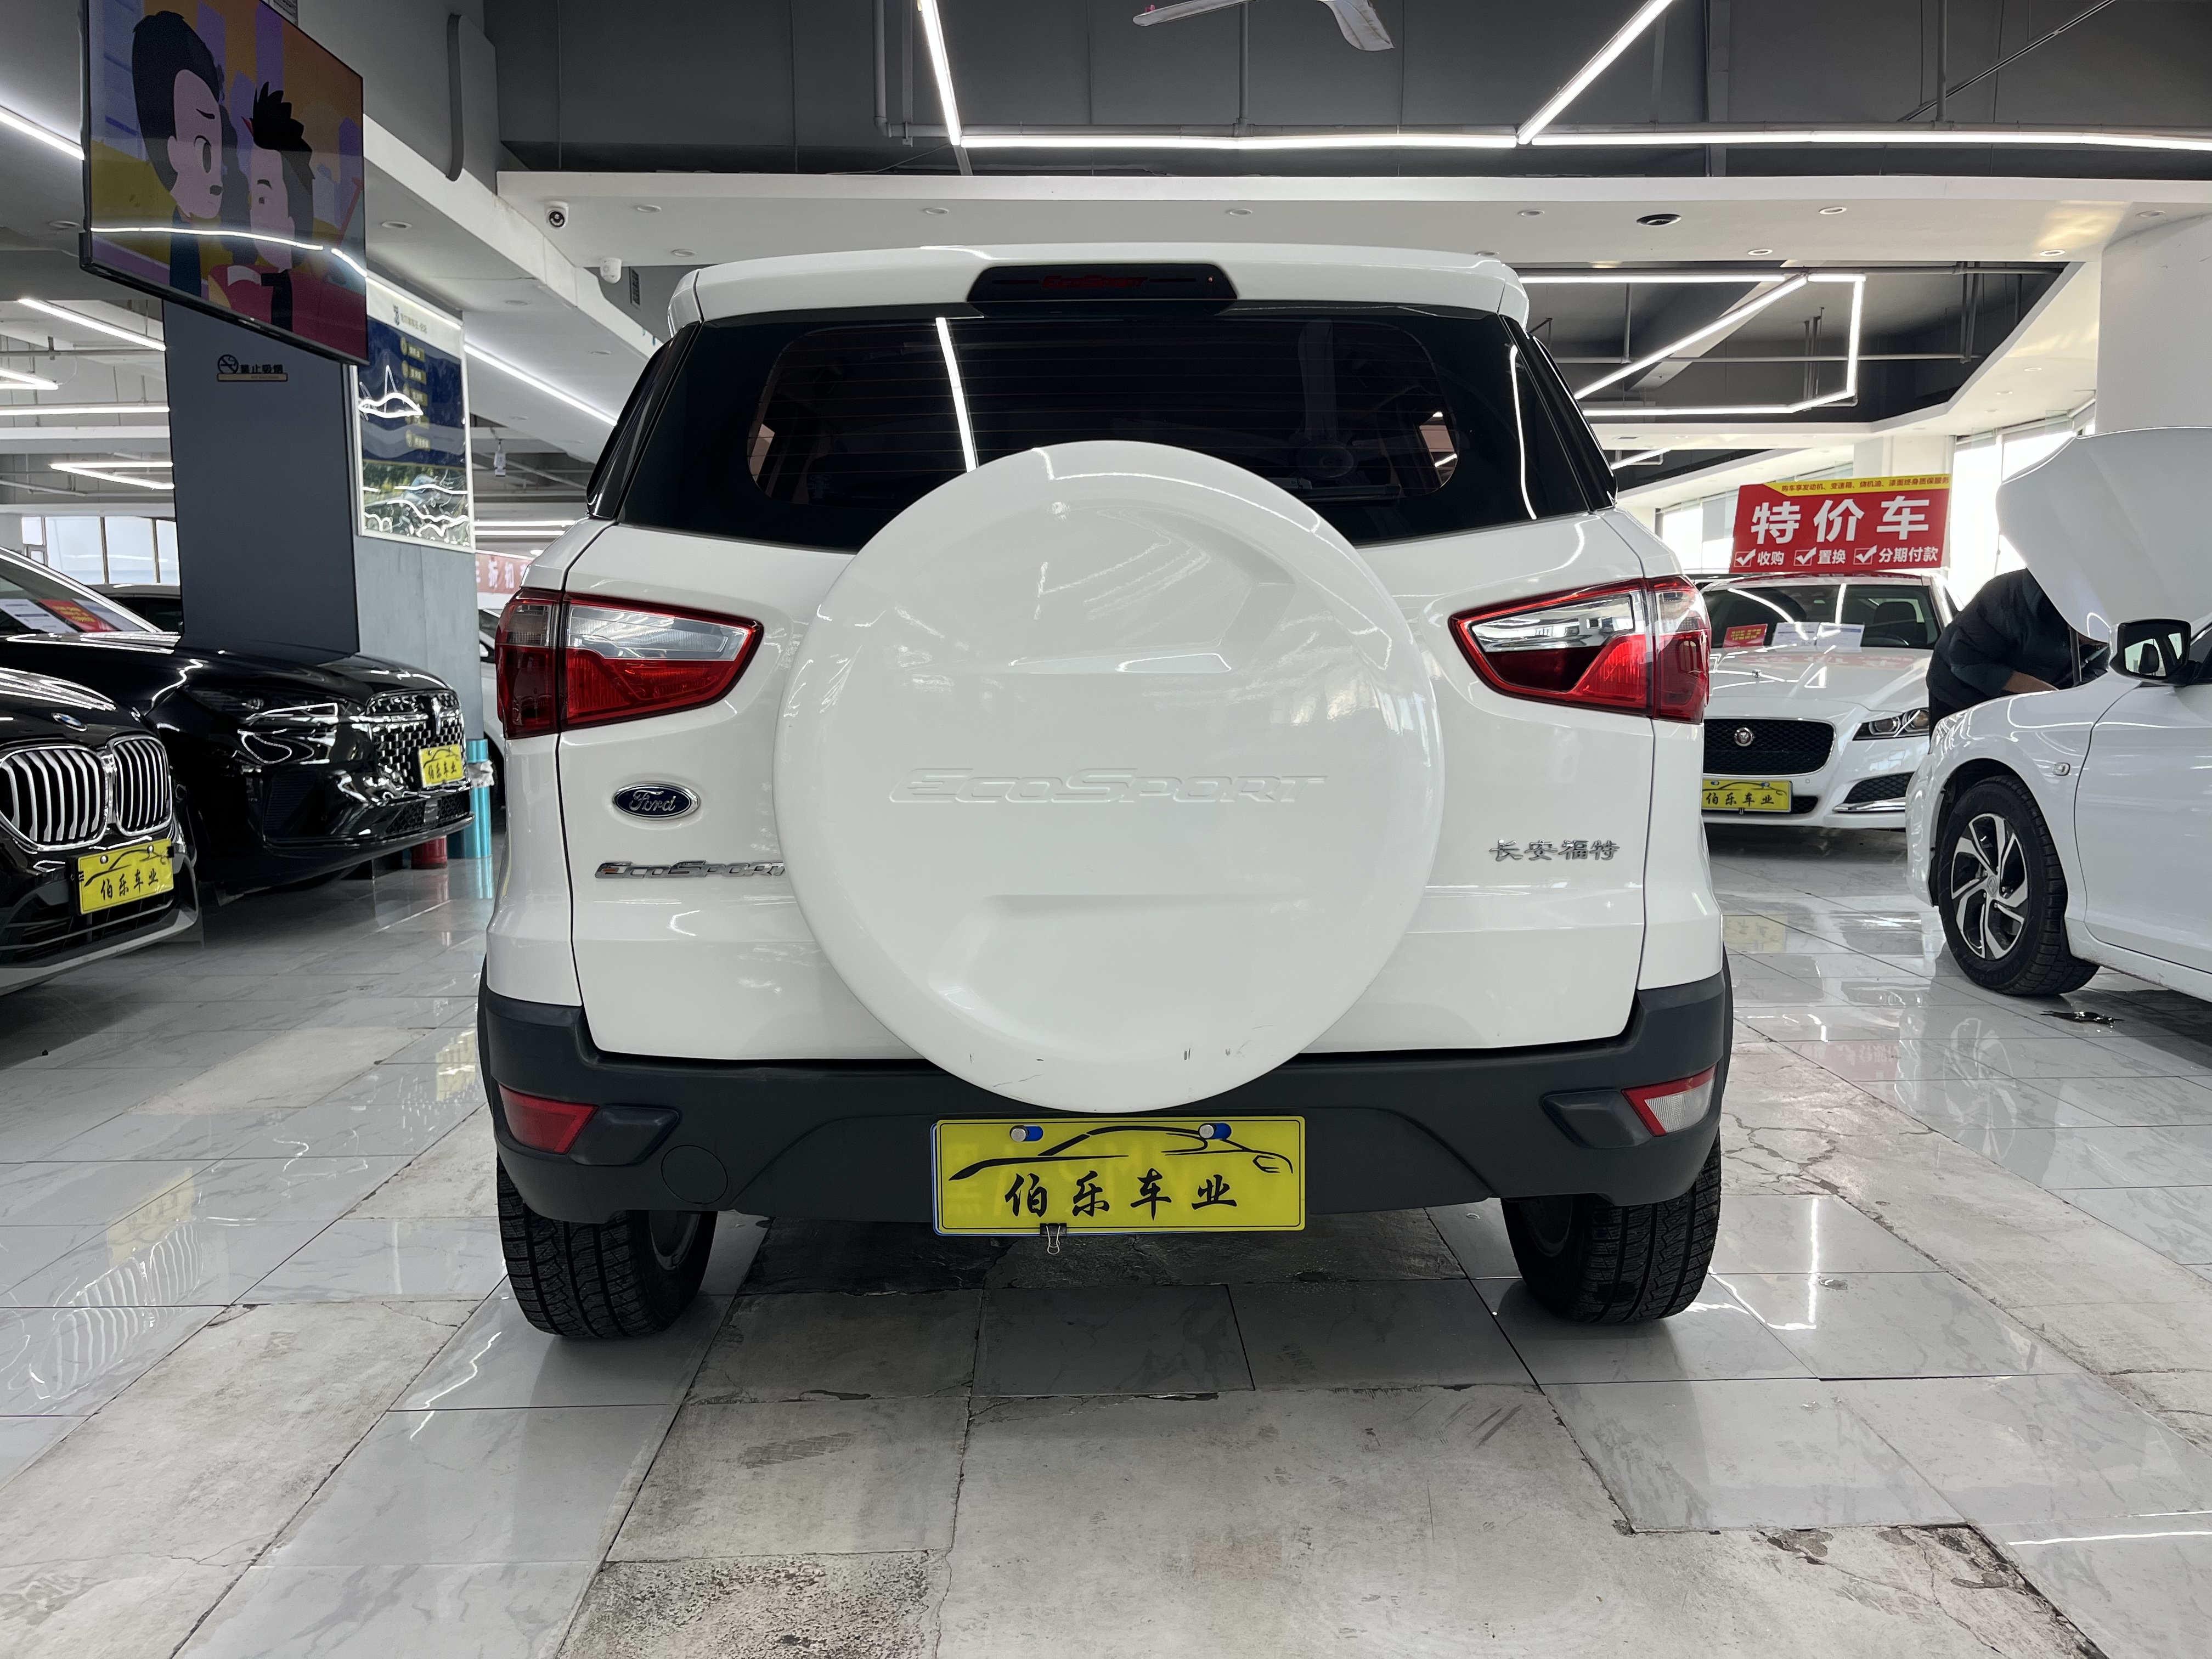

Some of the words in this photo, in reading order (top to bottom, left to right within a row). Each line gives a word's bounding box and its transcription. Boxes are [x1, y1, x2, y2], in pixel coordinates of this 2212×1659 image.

[1751, 495, 1930, 545] 特价车
[1757, 551, 1785, 566] 收购
[1818, 549, 1847, 565] 置换
[1878, 546, 1939, 563] 分期付款
[629, 789, 676, 811] Ford
[1706, 792, 1774, 807] 伯乐车业
[1489, 839, 1620, 862] 长安福特
[100, 868, 159, 901] 伯乐车业
[1005, 1168, 1237, 1221] 伯乐车业
